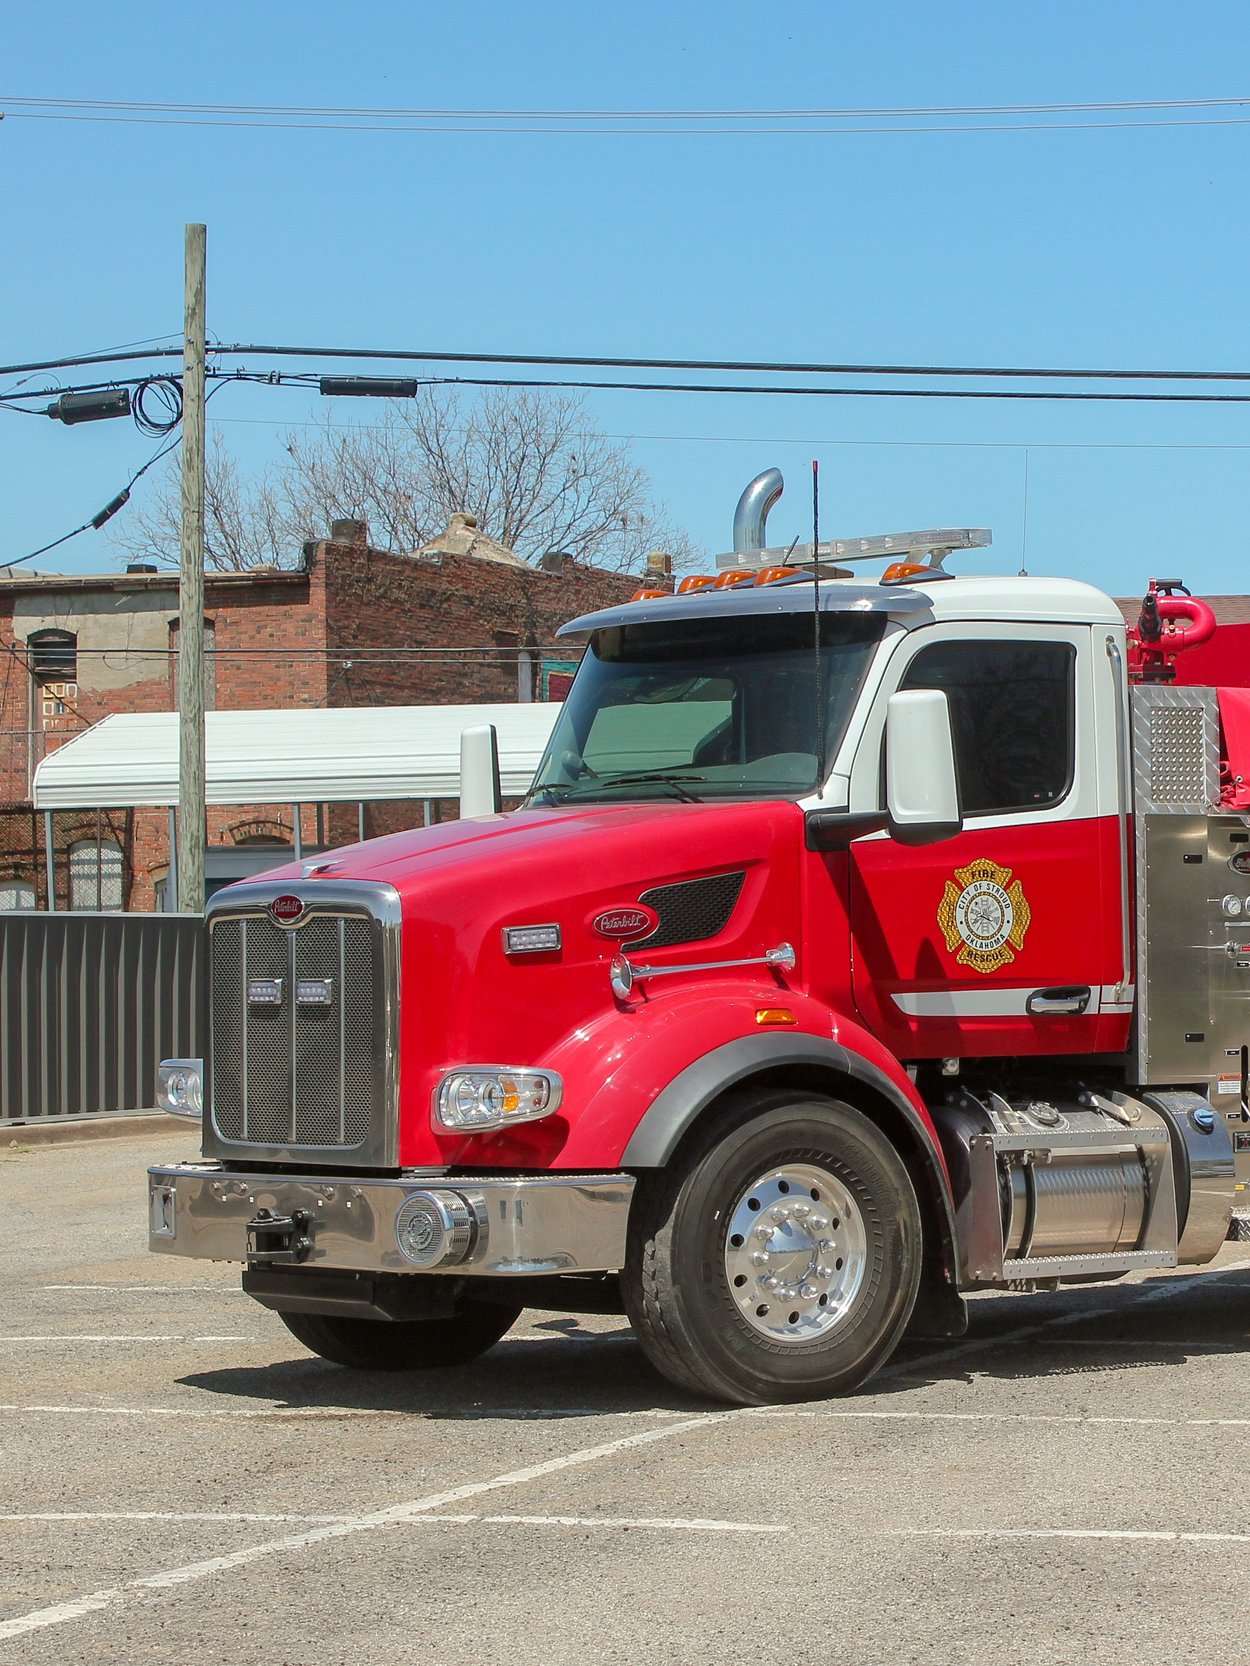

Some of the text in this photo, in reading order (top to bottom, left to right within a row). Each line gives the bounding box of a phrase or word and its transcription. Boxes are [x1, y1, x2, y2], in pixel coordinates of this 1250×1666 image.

[971, 869, 997, 880] FIRE
[958, 882, 1011, 911] CITY OF STROUD
[600, 914, 645, 931] Peterbilt
[965, 933, 1006, 950] OKLAHOMA
[966, 949, 1005, 962] RESCUE
